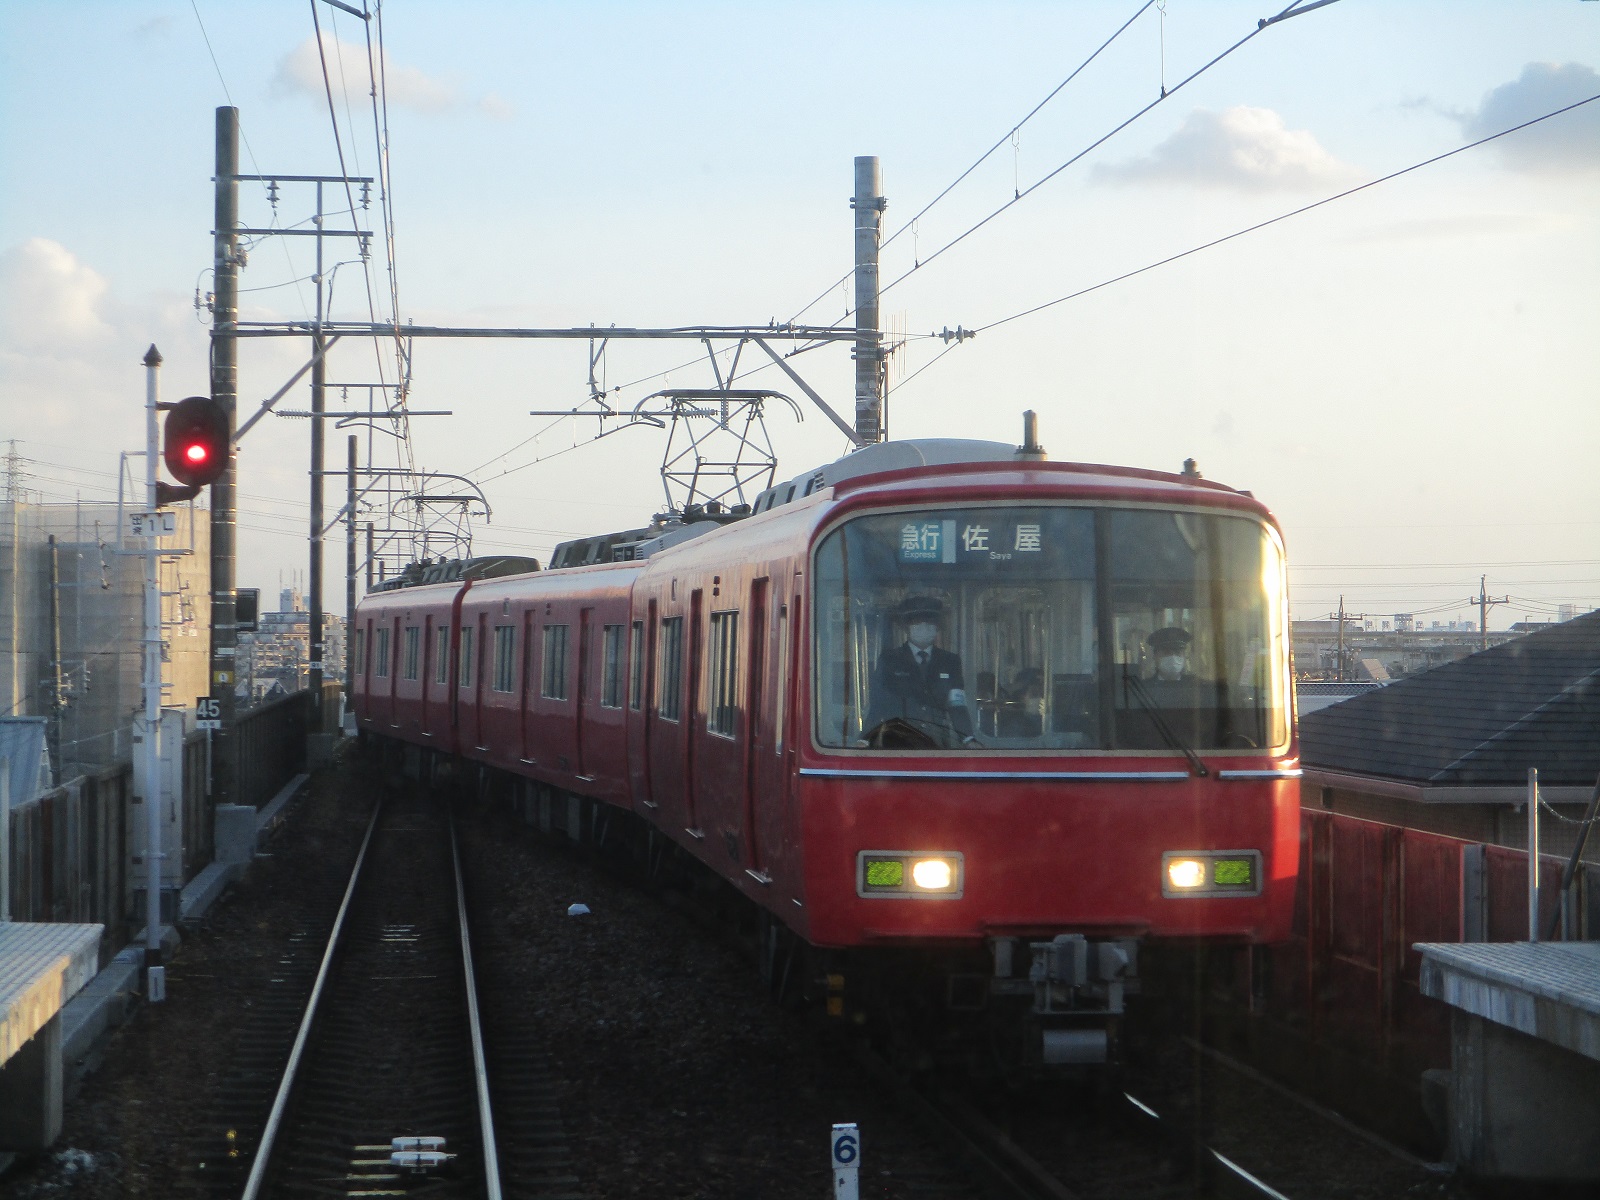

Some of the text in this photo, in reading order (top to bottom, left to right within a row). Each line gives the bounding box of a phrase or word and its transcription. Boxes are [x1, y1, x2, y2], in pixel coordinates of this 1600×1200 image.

[901, 523, 940, 551] 急行
[904, 551, 937, 559] Express
[989, 552, 1012, 560] Saya
[196, 699, 220, 718] 45
[834, 1135, 857, 1163] 6
